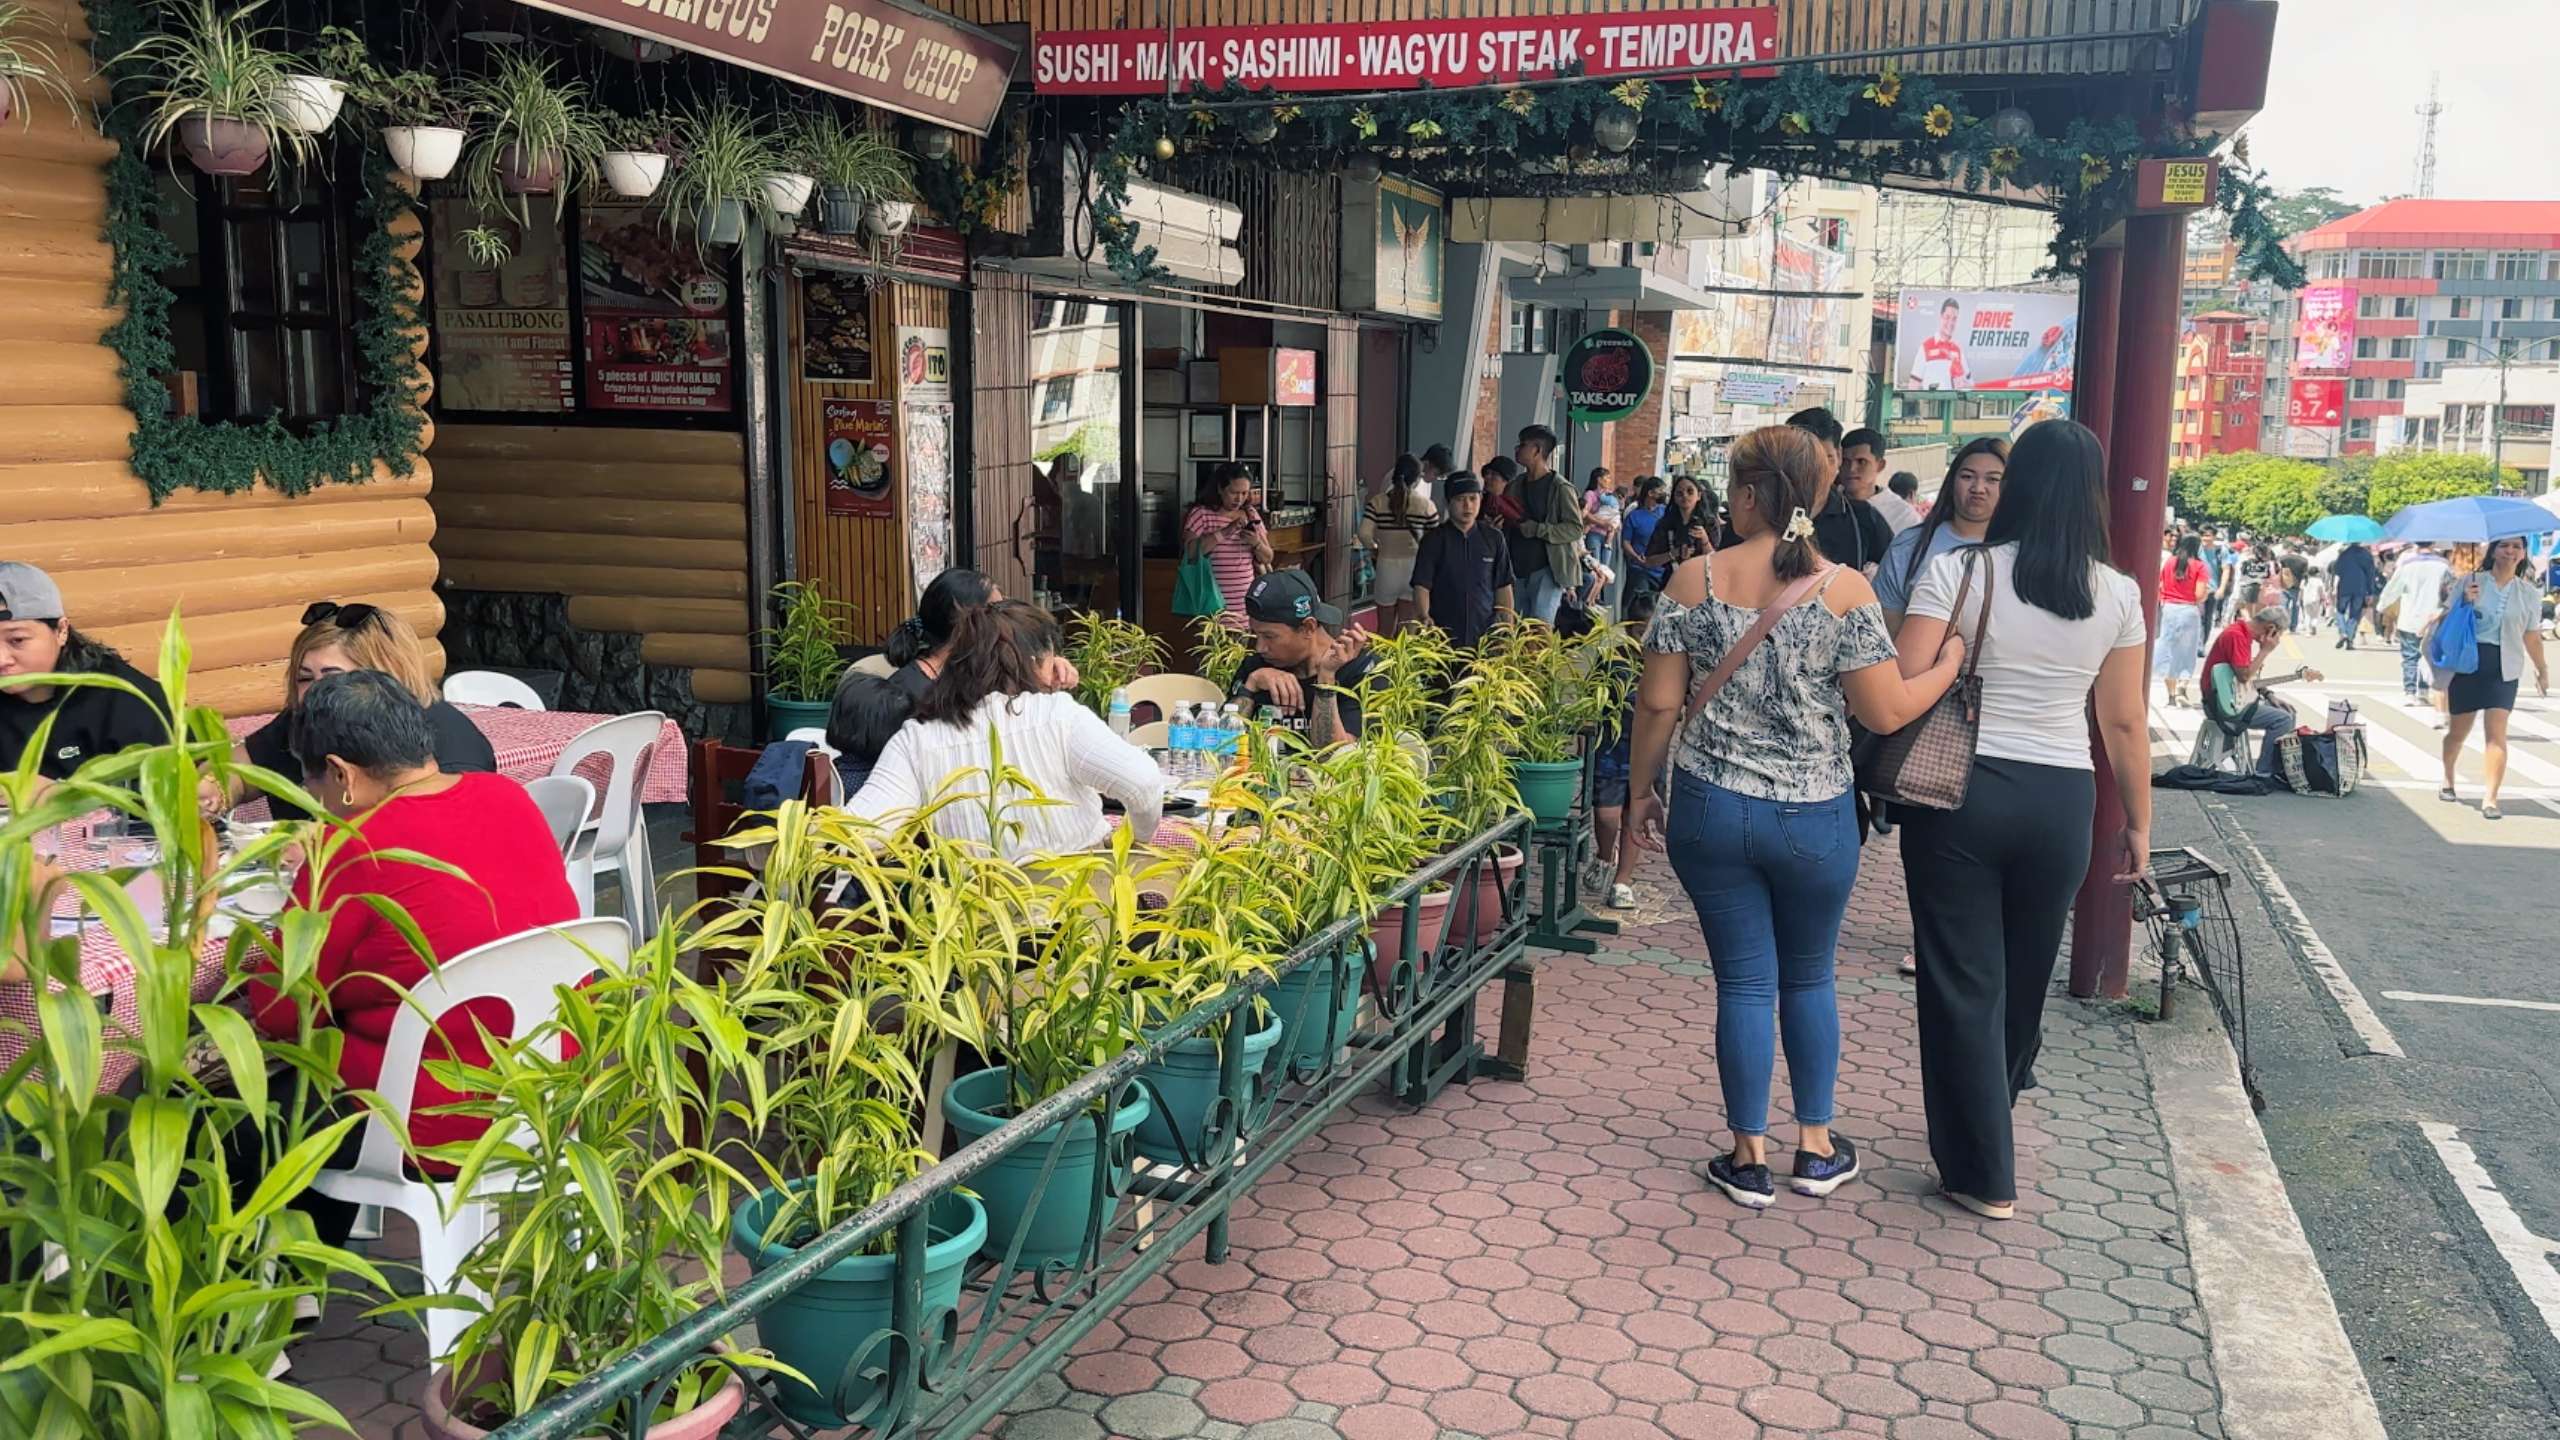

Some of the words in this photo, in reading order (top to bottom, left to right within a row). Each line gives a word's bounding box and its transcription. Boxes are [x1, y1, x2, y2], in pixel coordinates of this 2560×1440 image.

[810, 3, 906, 83] PORK
[903, 38, 979, 104] CHOP
[1037, 43, 1119, 84] SUSHI
[1135, 40, 1205, 82] MAKI
[1222, 36, 1342, 79] SASHIMI
[1358, 32, 1468, 77] WAGYU
[1477, 28, 1582, 73] STEAK
[1600, 21, 1757, 69] TEMPURA
[2167, 164, 2206, 177] JESUS
[444, 311, 565, 329] PASALUBONG
[1972, 310, 2014, 329] DRIVE
[1969, 330, 2030, 347] FURTHER
[598, 369, 605, 381] 5
[605, 370, 637, 382] pieces
[638, 370, 648, 381] of
[651, 371, 675, 382] JUICY
[677, 371, 701, 383] PORK
[1571, 391, 1638, 406] TAKE-OUT
